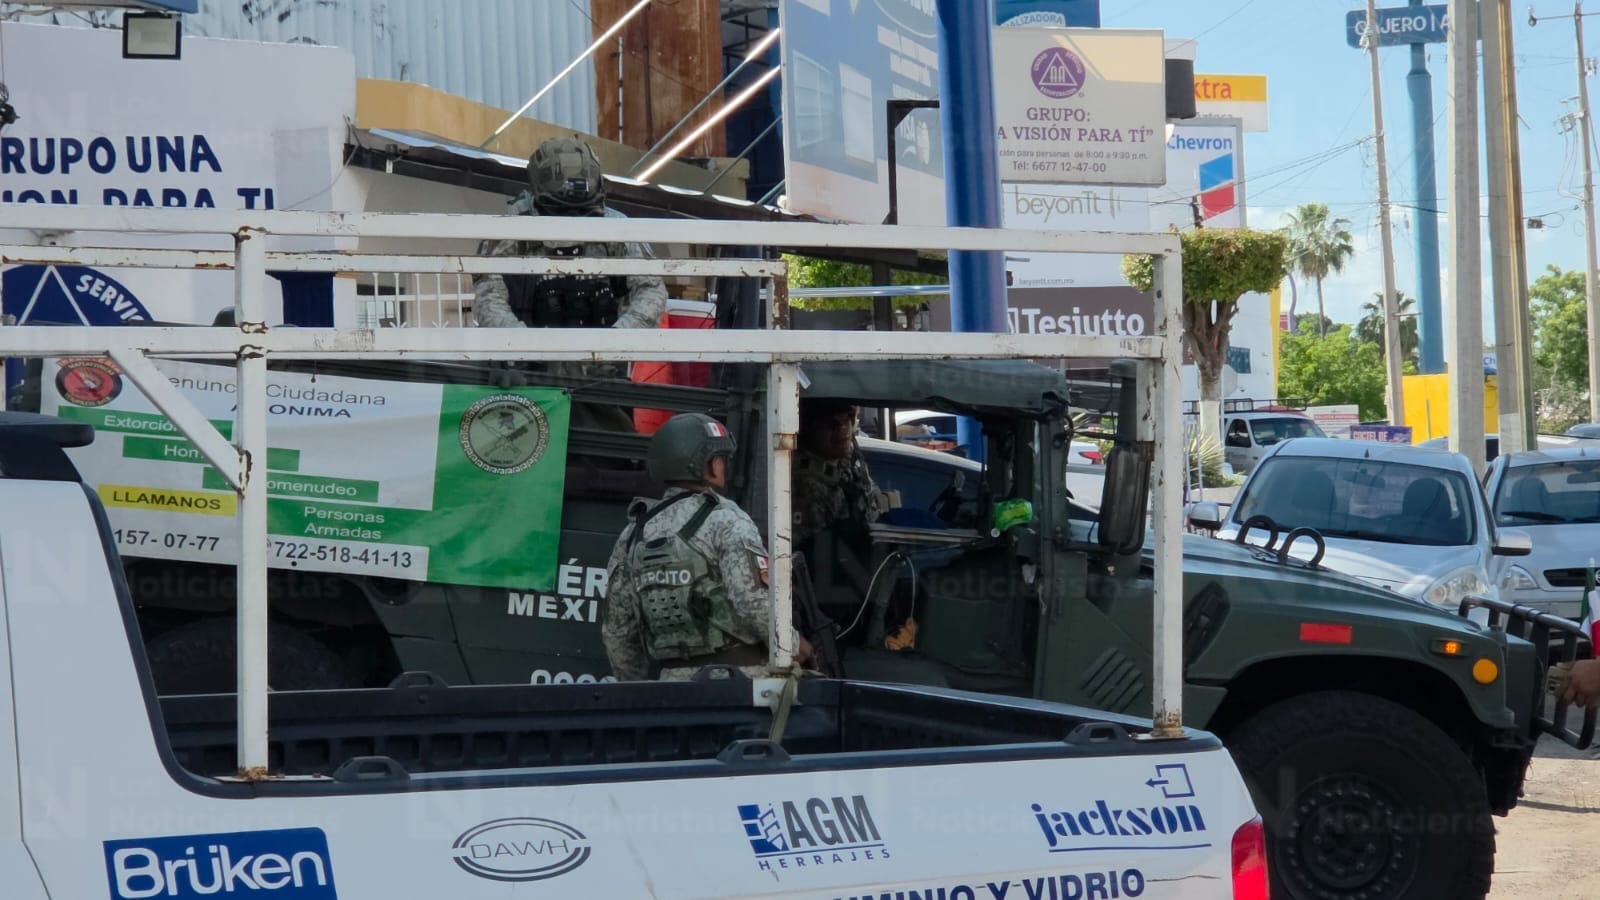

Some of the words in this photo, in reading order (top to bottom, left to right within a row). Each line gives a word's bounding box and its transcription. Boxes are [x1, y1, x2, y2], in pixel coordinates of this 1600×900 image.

[1026, 107, 1091, 122] GRUPO:
[1013, 124, 1071, 141] VISIÓN
[1078, 127, 1123, 143] PARA
[126, 134, 223, 173] UNA
[1032, 161, 1057, 171] 6677
[1060, 162, 1107, 173] 12-47-00
[75, 274, 145, 321] SERVI
[1021, 306, 1145, 336] Tesiutto
[168, 376, 238, 394] enunc
[266, 384, 386, 406] Ciudadana
[230, 402, 352, 418] ONIMA
[104, 415, 177, 432] Extorció
[265, 479, 358, 497] omenudeo
[113, 491, 222, 510] LLAMANOS
[304, 506, 385, 524] Personas
[304, 523, 382, 540] Armadas
[274, 541, 412, 568] 722-518-41-13
[507, 592, 598, 623] MEXI
[782, 795, 882, 850] AGM
[1031, 799, 1207, 848] jackson
[469, 837, 571, 861] DAWH
[759, 848, 891, 872] HERRAJES
[113, 844, 327, 900] Brüken
[1023, 868, 1146, 900] VIDRIO
